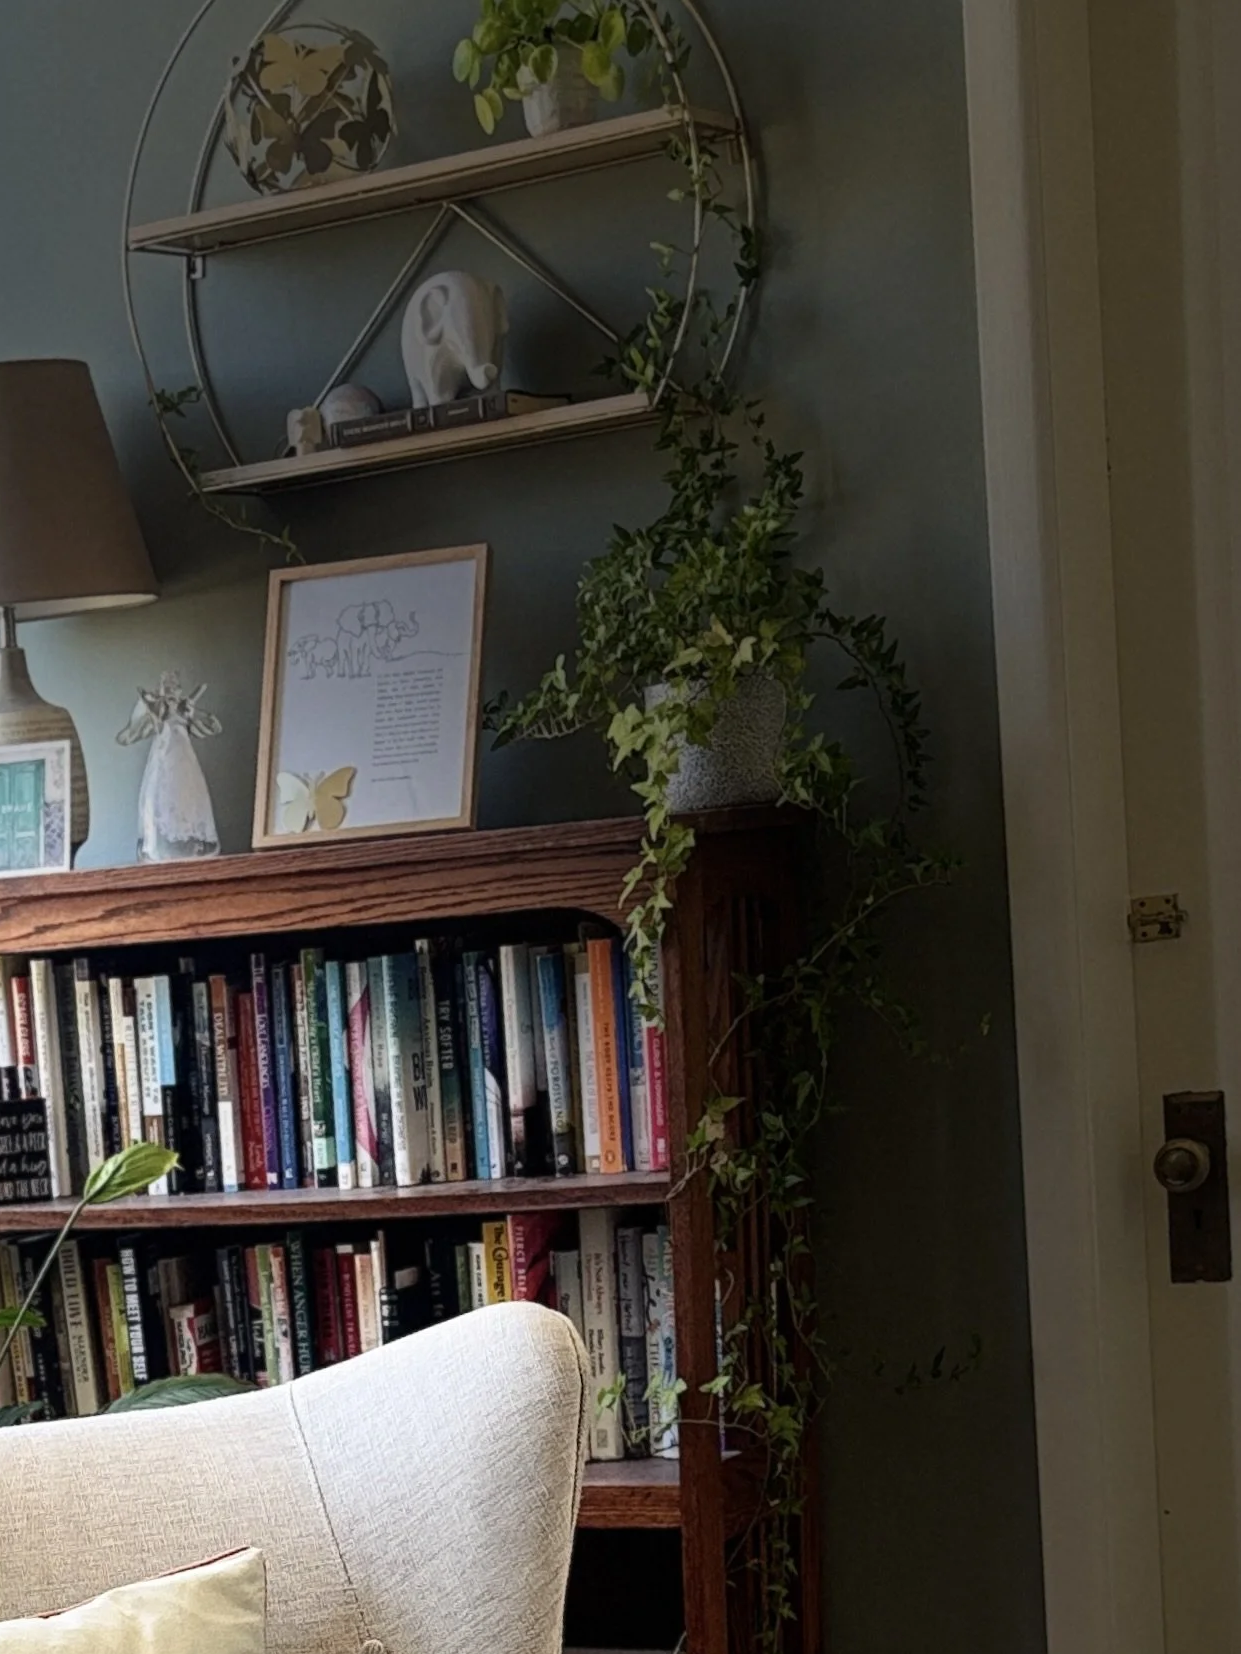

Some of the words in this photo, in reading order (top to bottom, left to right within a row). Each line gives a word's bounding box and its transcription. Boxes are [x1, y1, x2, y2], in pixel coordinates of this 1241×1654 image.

[1, 802, 33, 815] BRAVE
[139, 1001, 147, 1033] TALK
[146, 1001, 155, 1041] DON'T
[438, 1000, 450, 1021] TRY
[141, 1038, 151, 1082] ABOUT
[439, 1027, 455, 1070] SOFTER
[149, 1046, 158, 1084] WANT
[152, 1088, 159, 1104] TO
[604, 1041, 612, 1064] BODY
[608, 1114, 616, 1142] SCORE
[22, 1112, 43, 1130] you
[21, 1154, 47, 1176] hug
[494, 1225, 505, 1244] The
[515, 1226, 526, 1263] FIERCE
[119, 1249, 136, 1276] HOW
[290, 1241, 306, 1286] WHEN
[493, 1247, 509, 1297] Courage
[595, 1267, 603, 1283] Not
[123, 1279, 138, 1292] TO
[596, 1285, 605, 1315] Always
[126, 1294, 142, 1322] MEET
[293, 1290, 310, 1339] ANGER
[129, 1325, 145, 1354] YOUR
[133, 1356, 148, 1381] SELF
